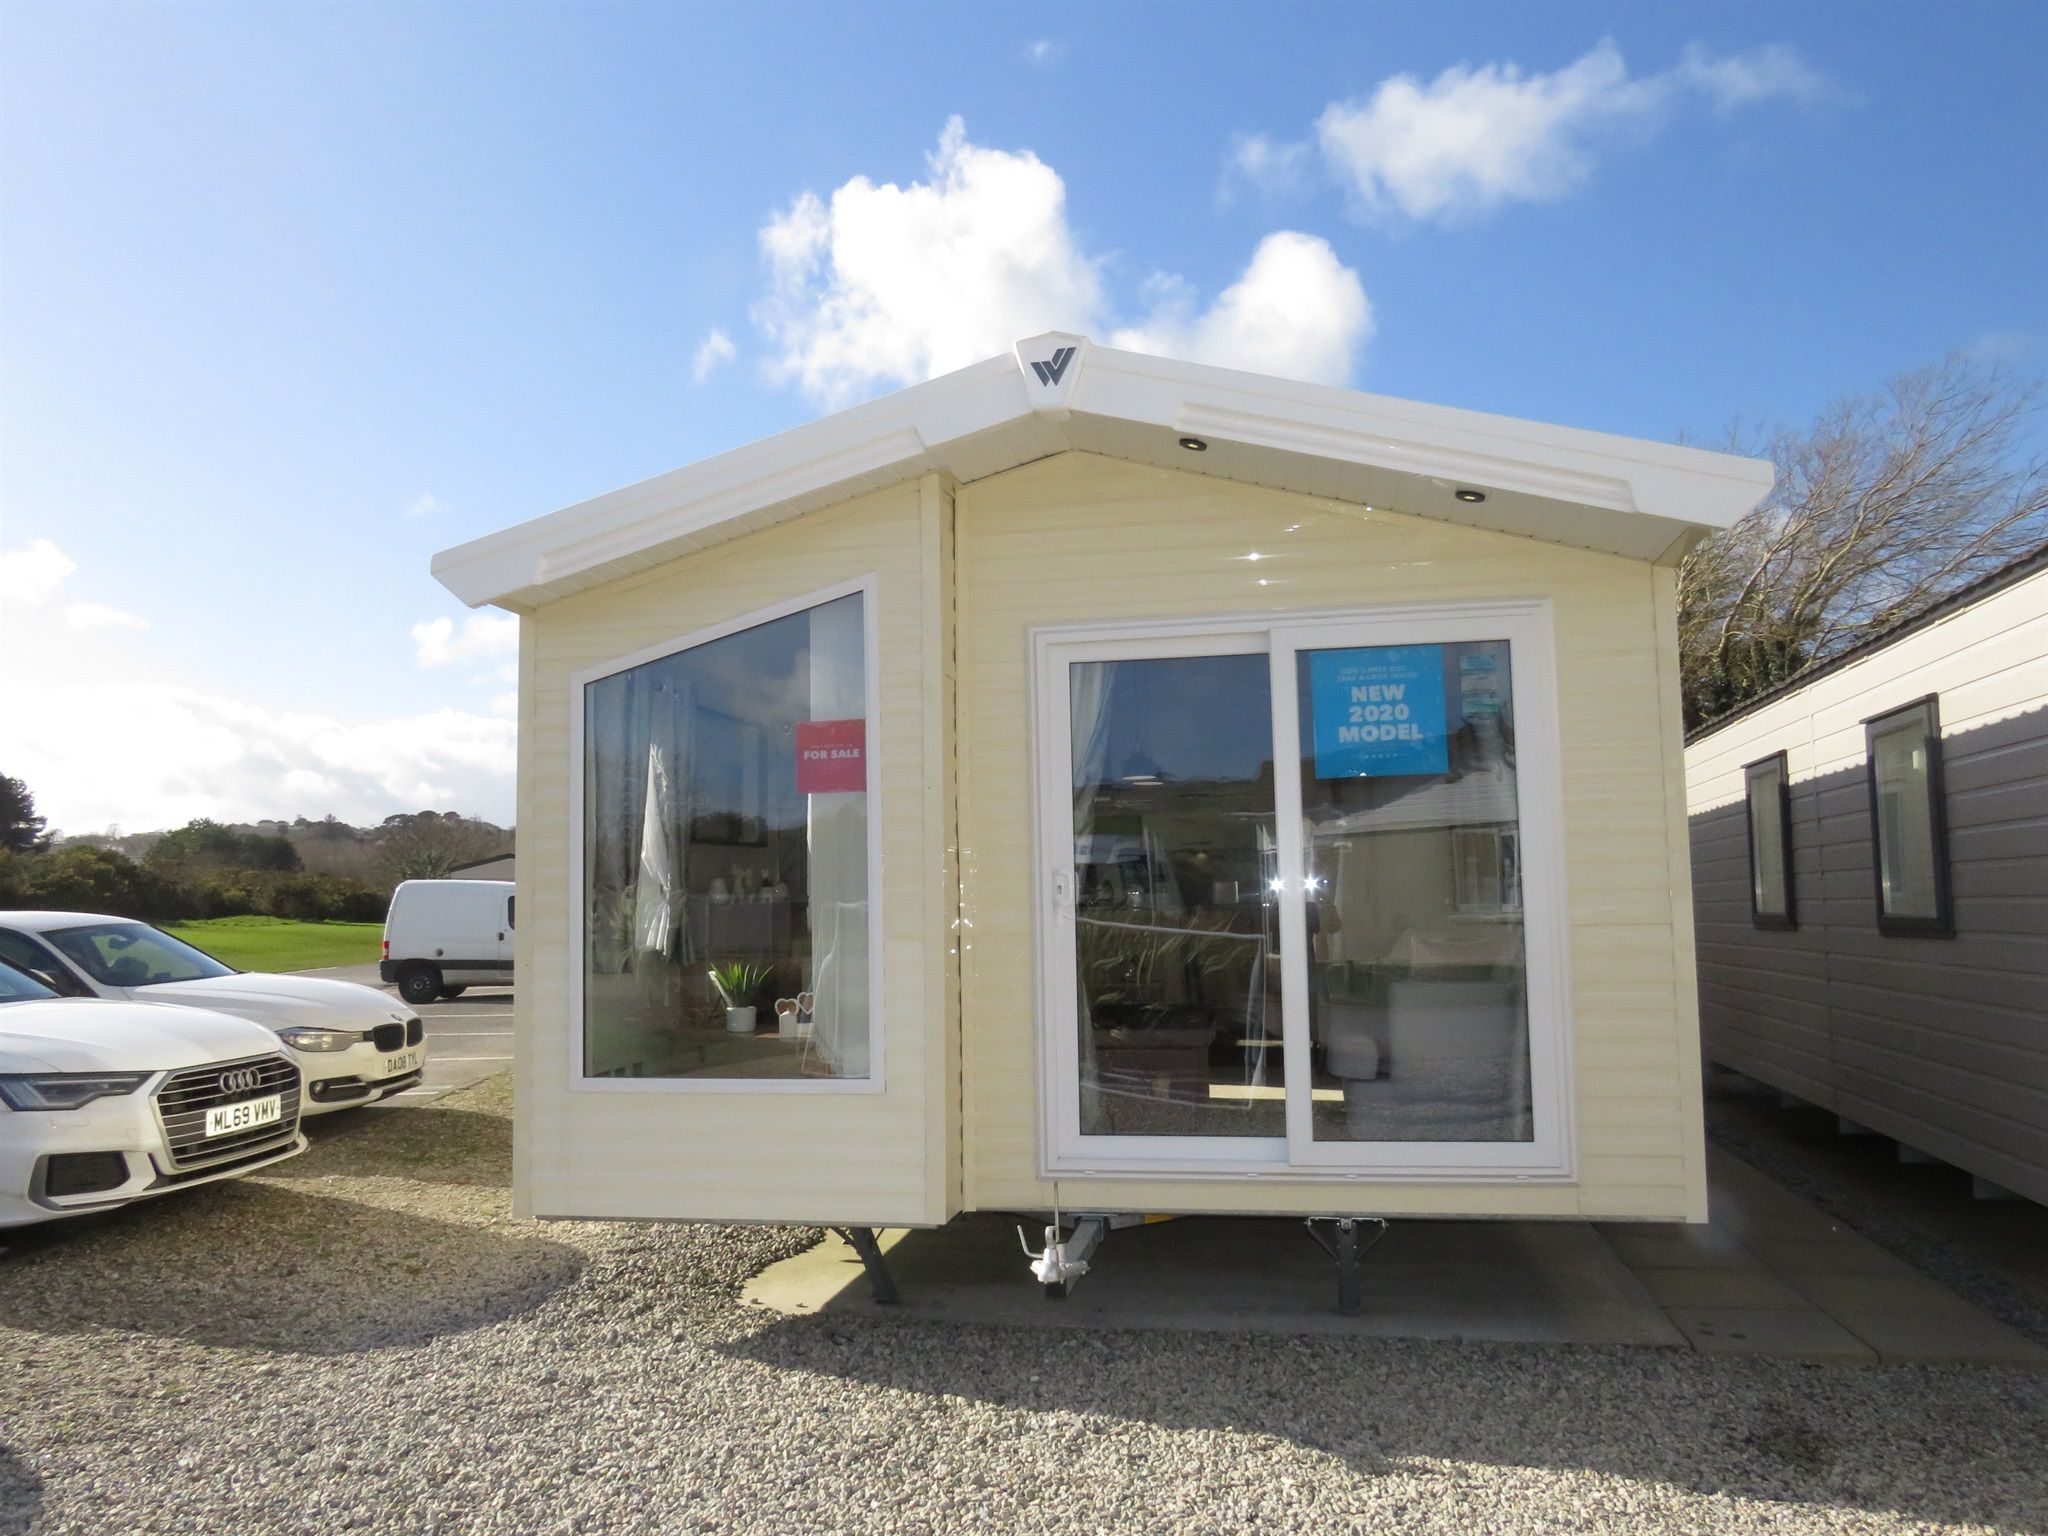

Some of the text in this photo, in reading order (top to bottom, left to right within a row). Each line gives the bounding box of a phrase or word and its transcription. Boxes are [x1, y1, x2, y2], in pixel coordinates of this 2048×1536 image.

[1351, 684, 1406, 703] NEW
[1349, 703, 1410, 723] 2020
[1338, 723, 1423, 743] MODEL
[803, 748, 860, 760] FOR SALE
[214, 1099, 276, 1132] ML69 VMV
